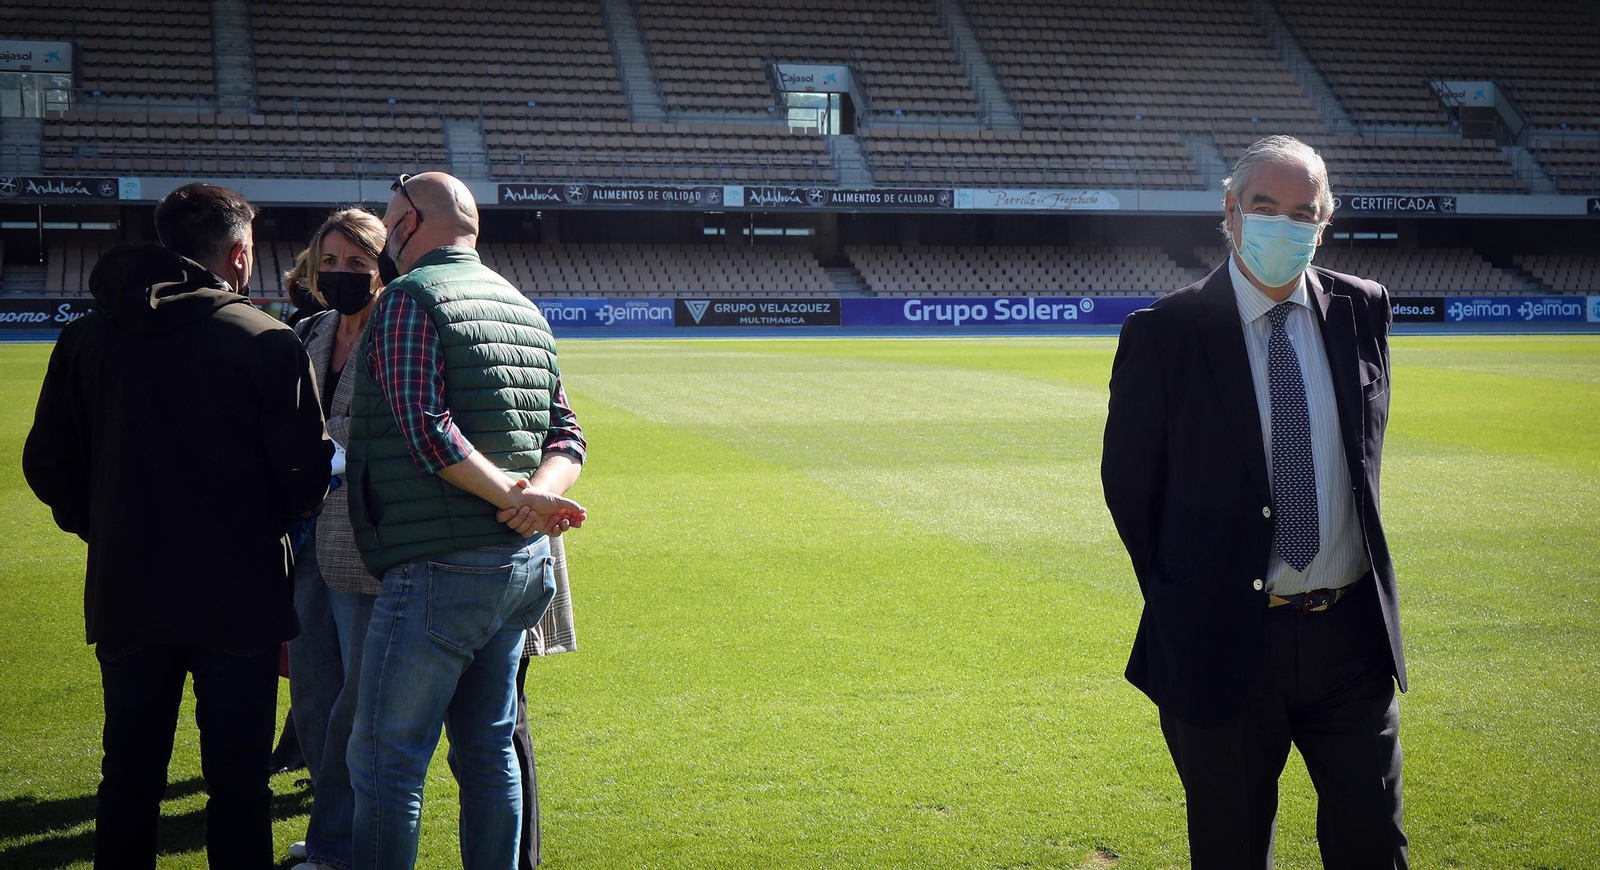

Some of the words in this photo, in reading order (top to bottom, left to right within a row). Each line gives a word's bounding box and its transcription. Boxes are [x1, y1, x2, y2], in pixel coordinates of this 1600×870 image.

[781, 73, 814, 84] Cajasol
[26, 180, 92, 195] Andalucía
[504, 187, 562, 201] Andalucía
[592, 190, 645, 200] ALIMENTOS
[647, 190, 659, 200] DE
[662, 190, 701, 201] CALIDAD
[831, 192, 881, 203] ALIMENTOS
[884, 193, 895, 203] DE
[897, 193, 935, 203] CALIDAD
[988, 189, 1036, 207] Parrilla
[1351, 197, 1435, 210] CERTIFICADA
[714, 303, 756, 313] GRUPO
[759, 303, 831, 313] VELAZQUEZ
[903, 299, 988, 326] Grupo
[994, 297, 1078, 320] Solera
[739, 316, 805, 324] MULTIMARCA
